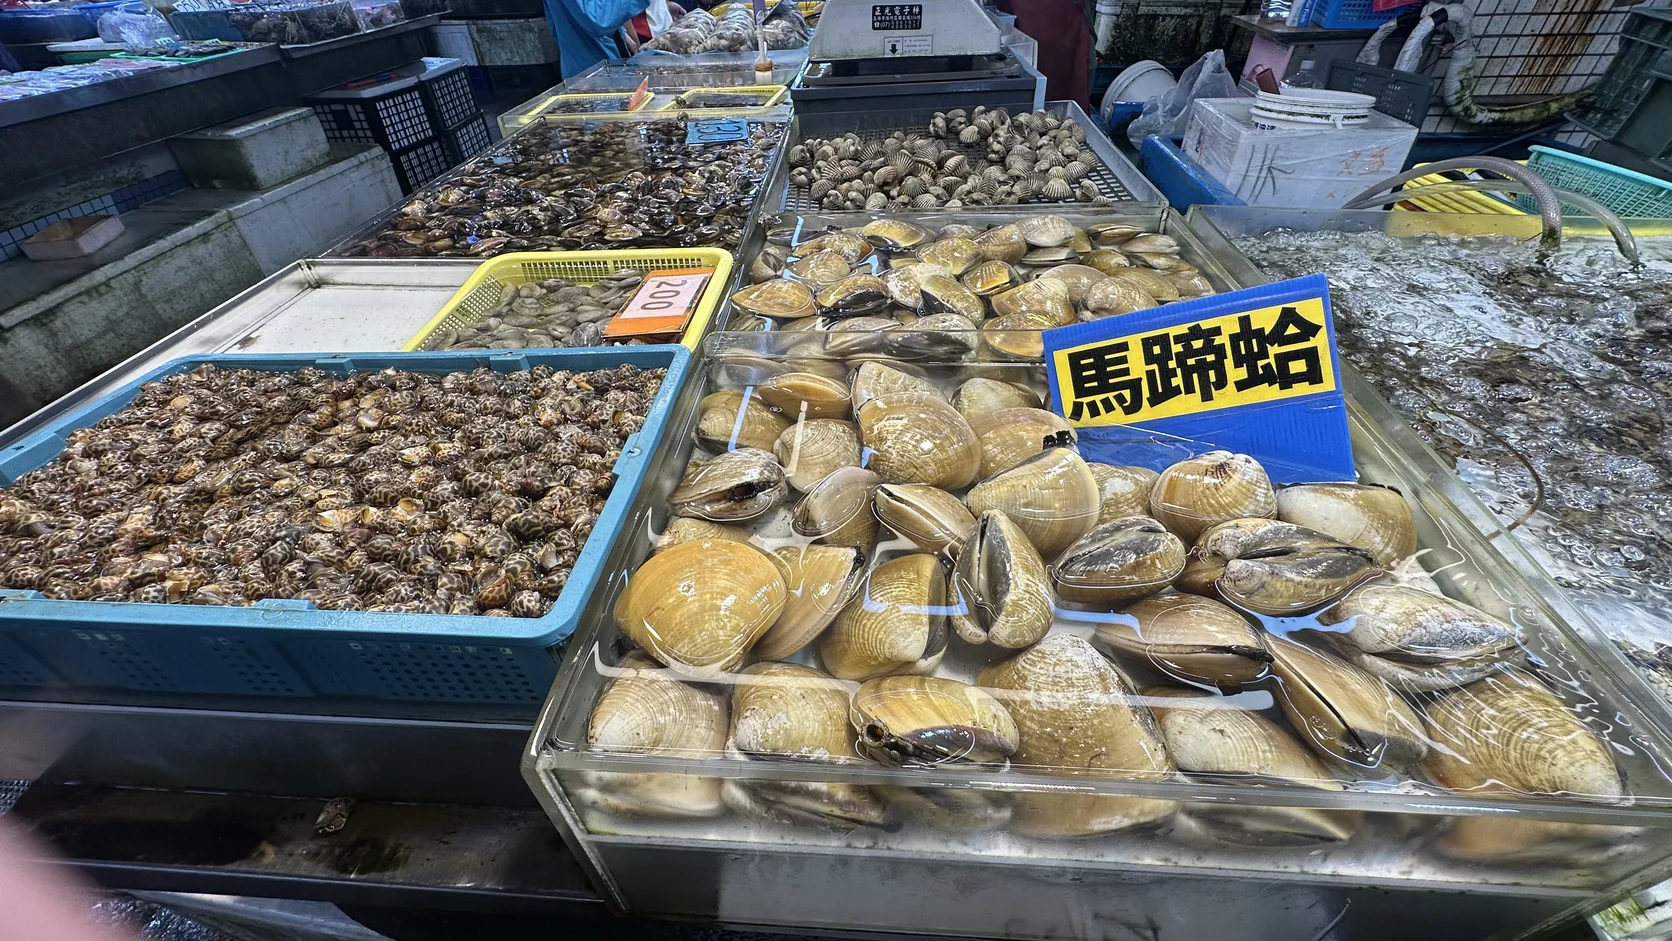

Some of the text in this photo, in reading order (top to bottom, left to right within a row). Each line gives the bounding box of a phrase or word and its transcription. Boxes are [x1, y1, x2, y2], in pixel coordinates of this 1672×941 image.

[694, 120, 744, 141] 130
[640, 280, 688, 311] 200
[1067, 306, 1324, 422] 馬蹄蛤
